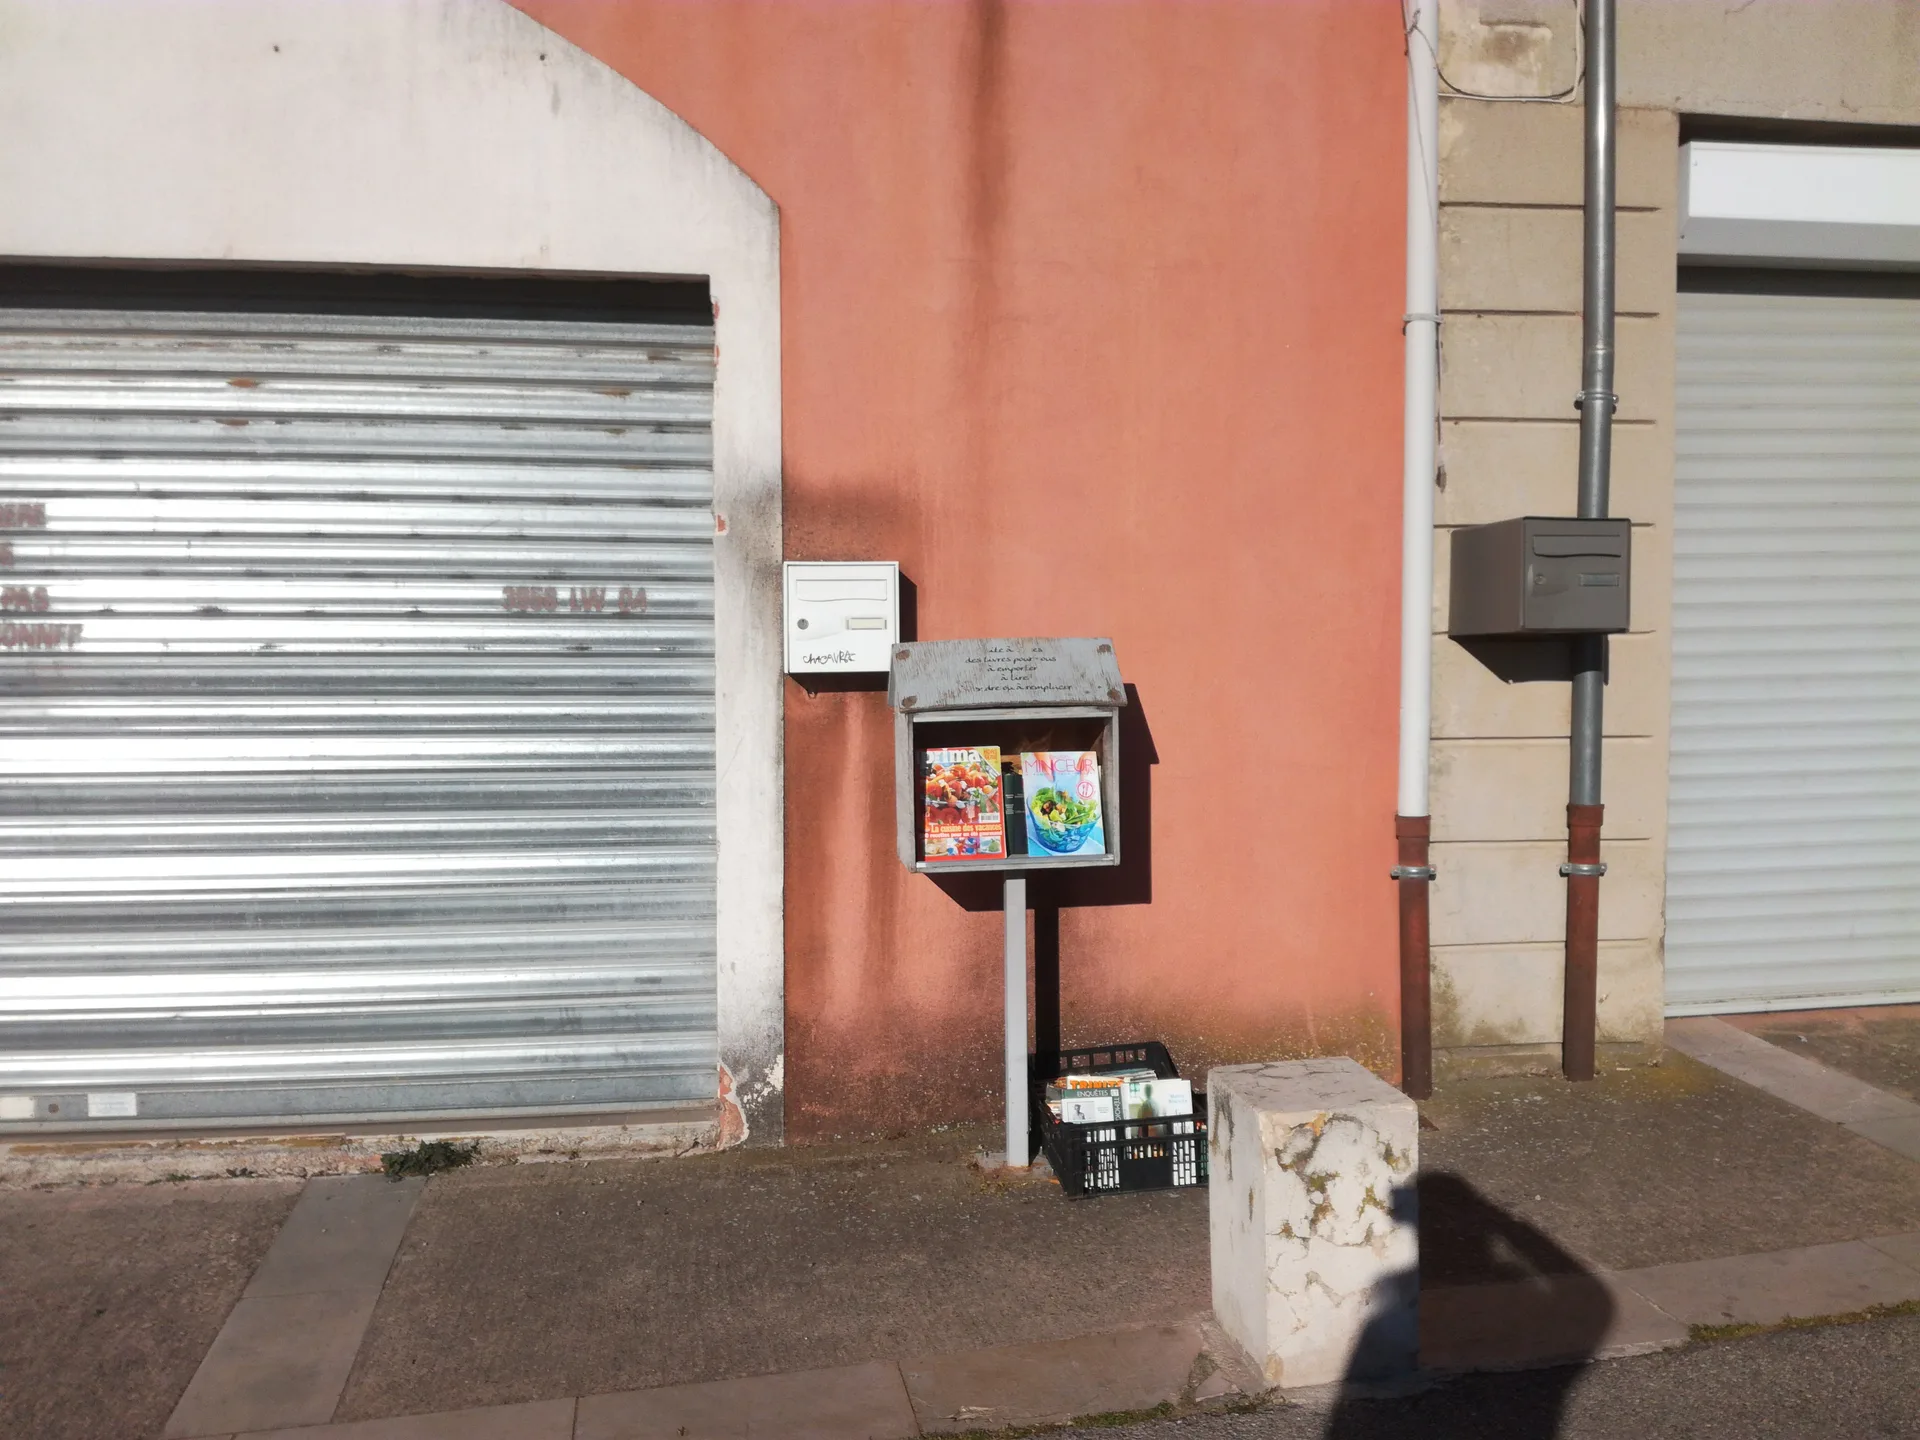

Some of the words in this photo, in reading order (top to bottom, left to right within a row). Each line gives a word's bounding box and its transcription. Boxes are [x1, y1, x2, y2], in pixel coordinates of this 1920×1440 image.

[984, 655, 1011, 663] livres
[997, 664, 1038, 674] emporter
[1024, 758, 1096, 773] MINCEUR
[1076, 1089, 1108, 1098] ENQUÊTES
